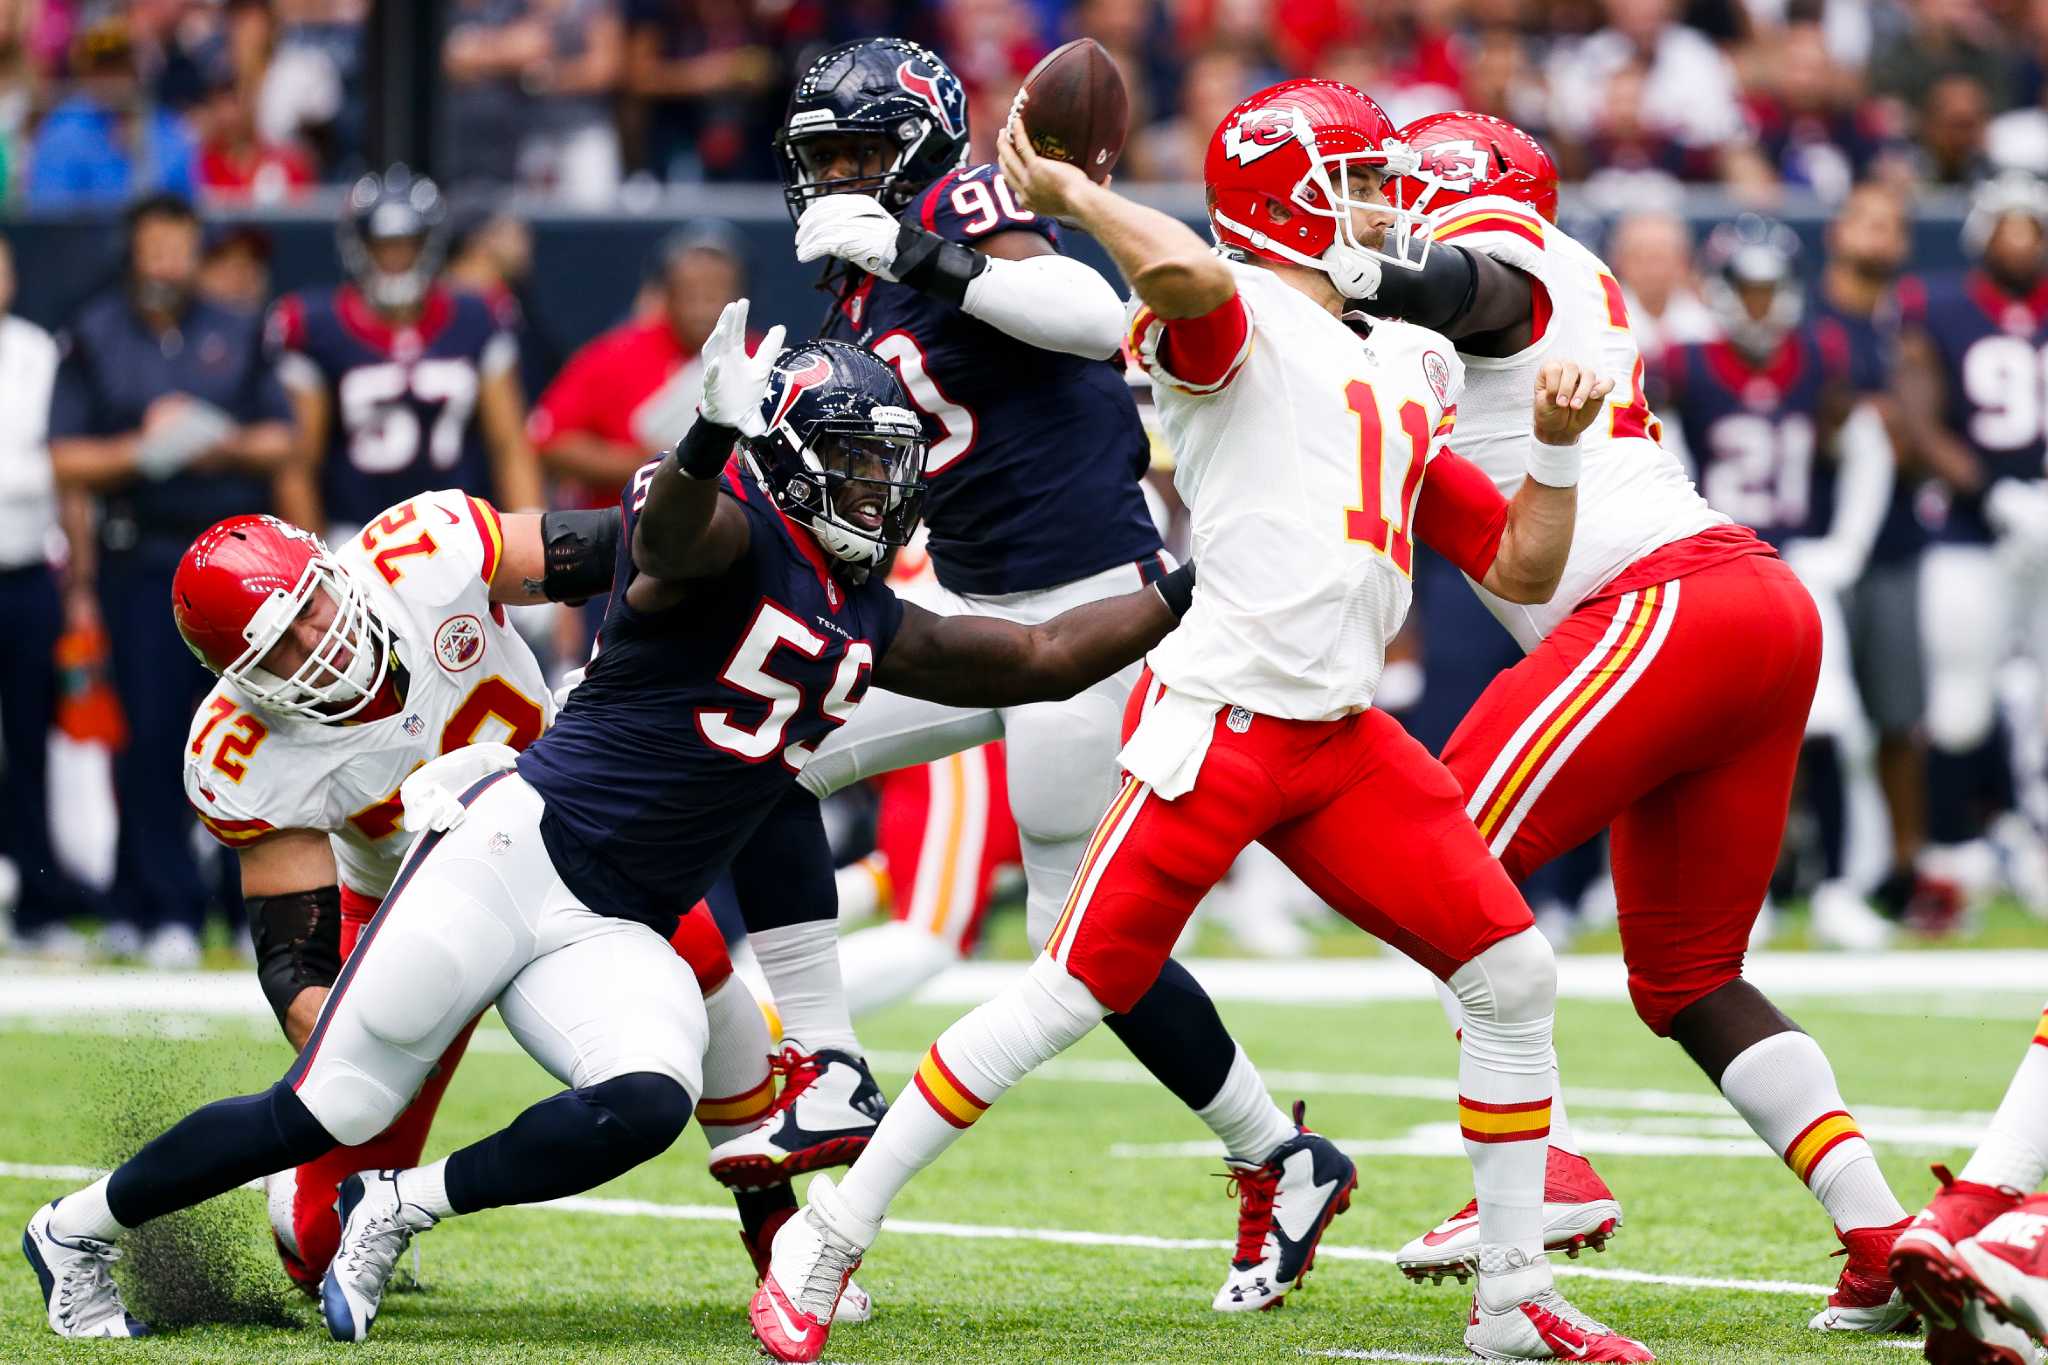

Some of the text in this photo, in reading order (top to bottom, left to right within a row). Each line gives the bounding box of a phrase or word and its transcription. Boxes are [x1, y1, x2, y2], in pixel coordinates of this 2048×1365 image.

[340, 357, 477, 473] 57
[1702, 413, 1815, 530] 21
[1343, 379, 1431, 581] 11
[191, 694, 269, 785] 72
[696, 597, 874, 773] 59
